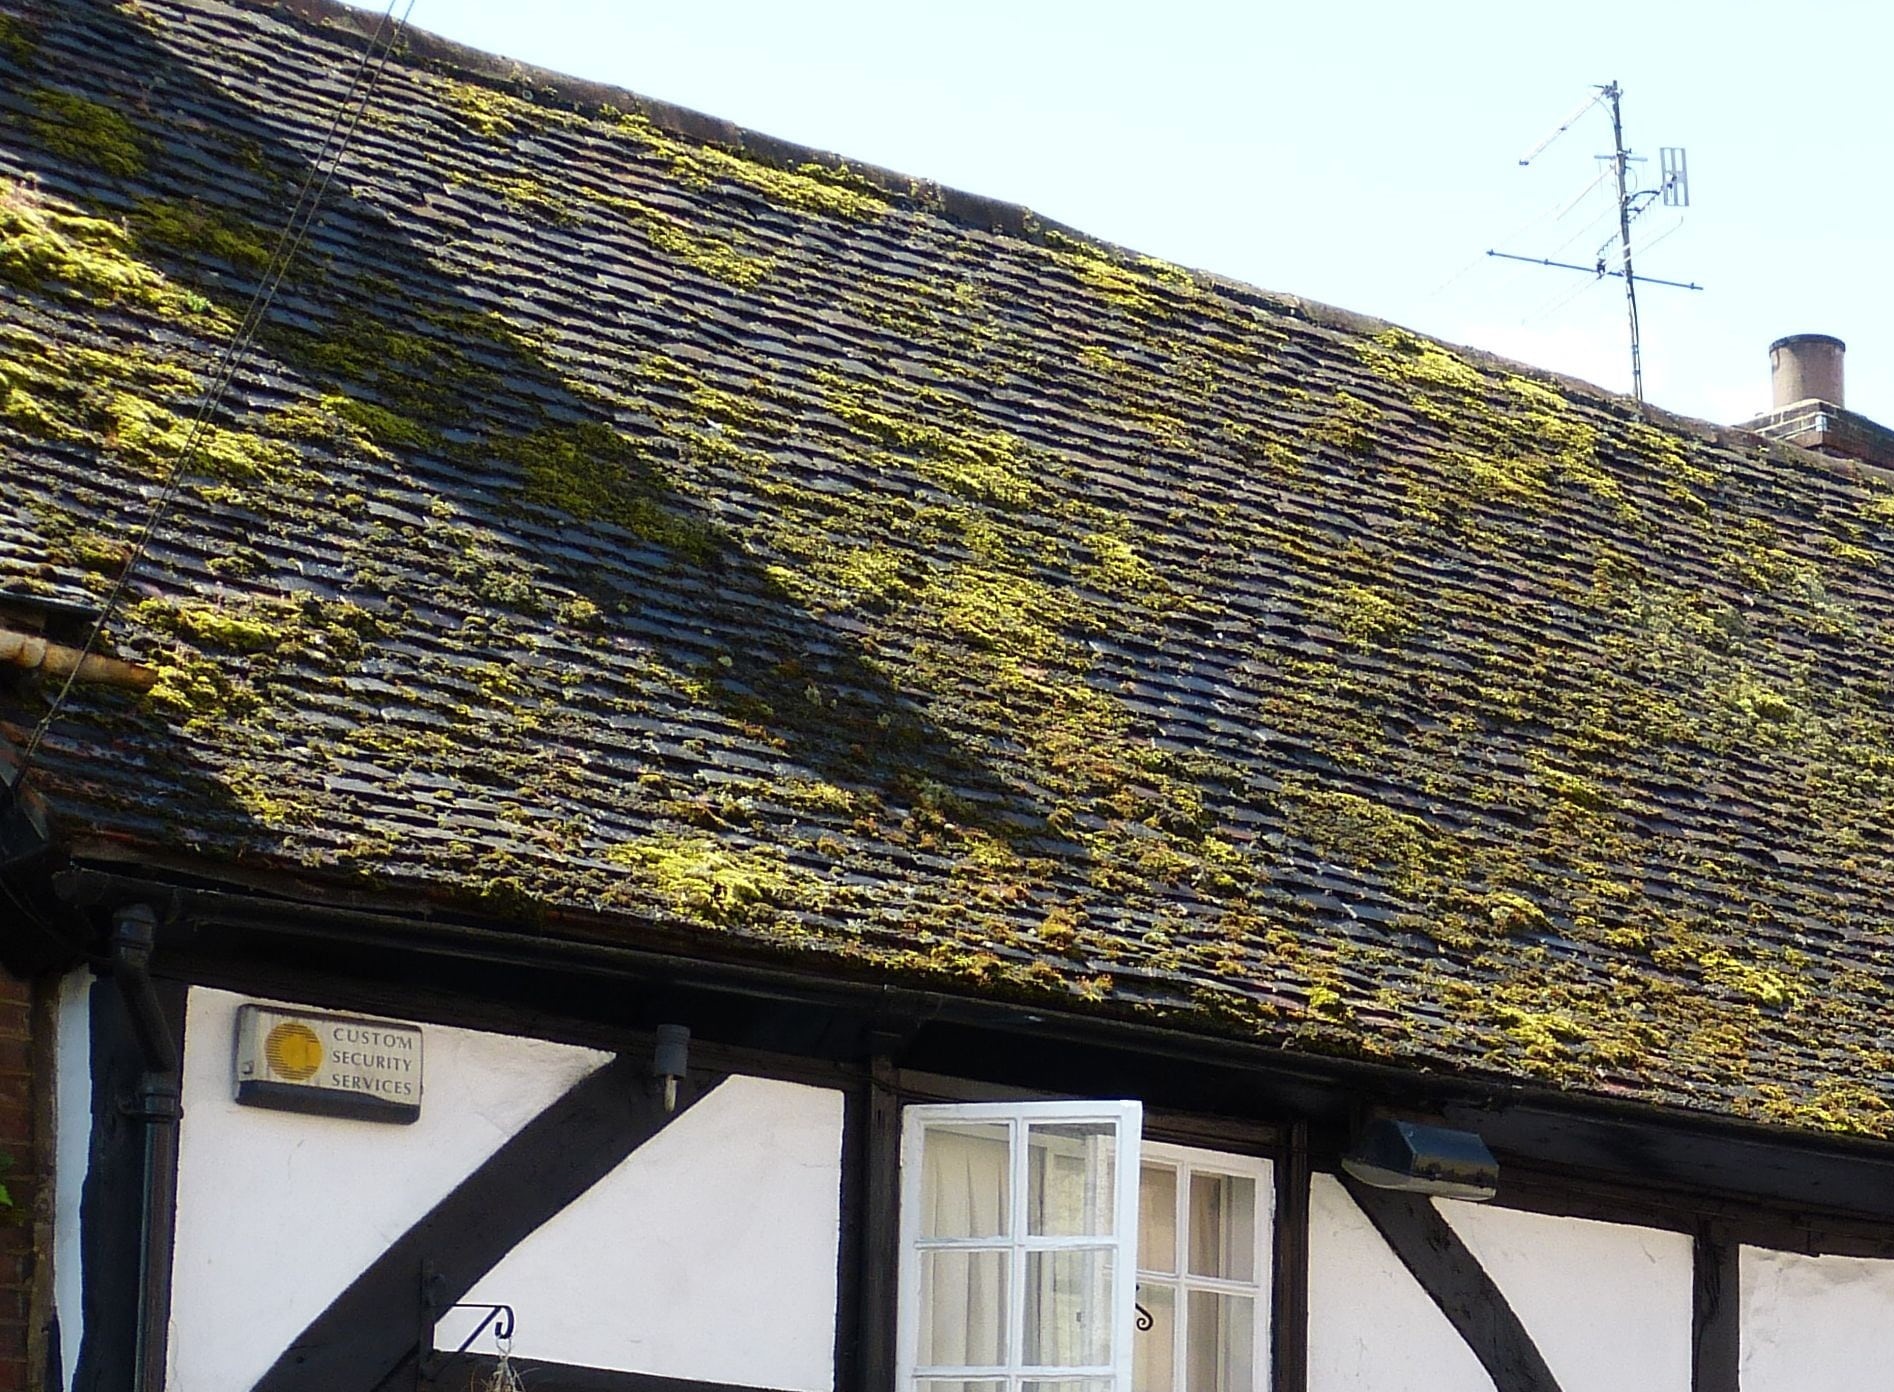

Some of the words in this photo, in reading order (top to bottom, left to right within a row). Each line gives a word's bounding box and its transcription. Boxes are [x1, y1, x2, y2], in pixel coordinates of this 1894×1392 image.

[333, 1028, 412, 1050] CUSTOM
[332, 1051, 412, 1072] SECURITY
[332, 1073, 411, 1095] SERVICES
